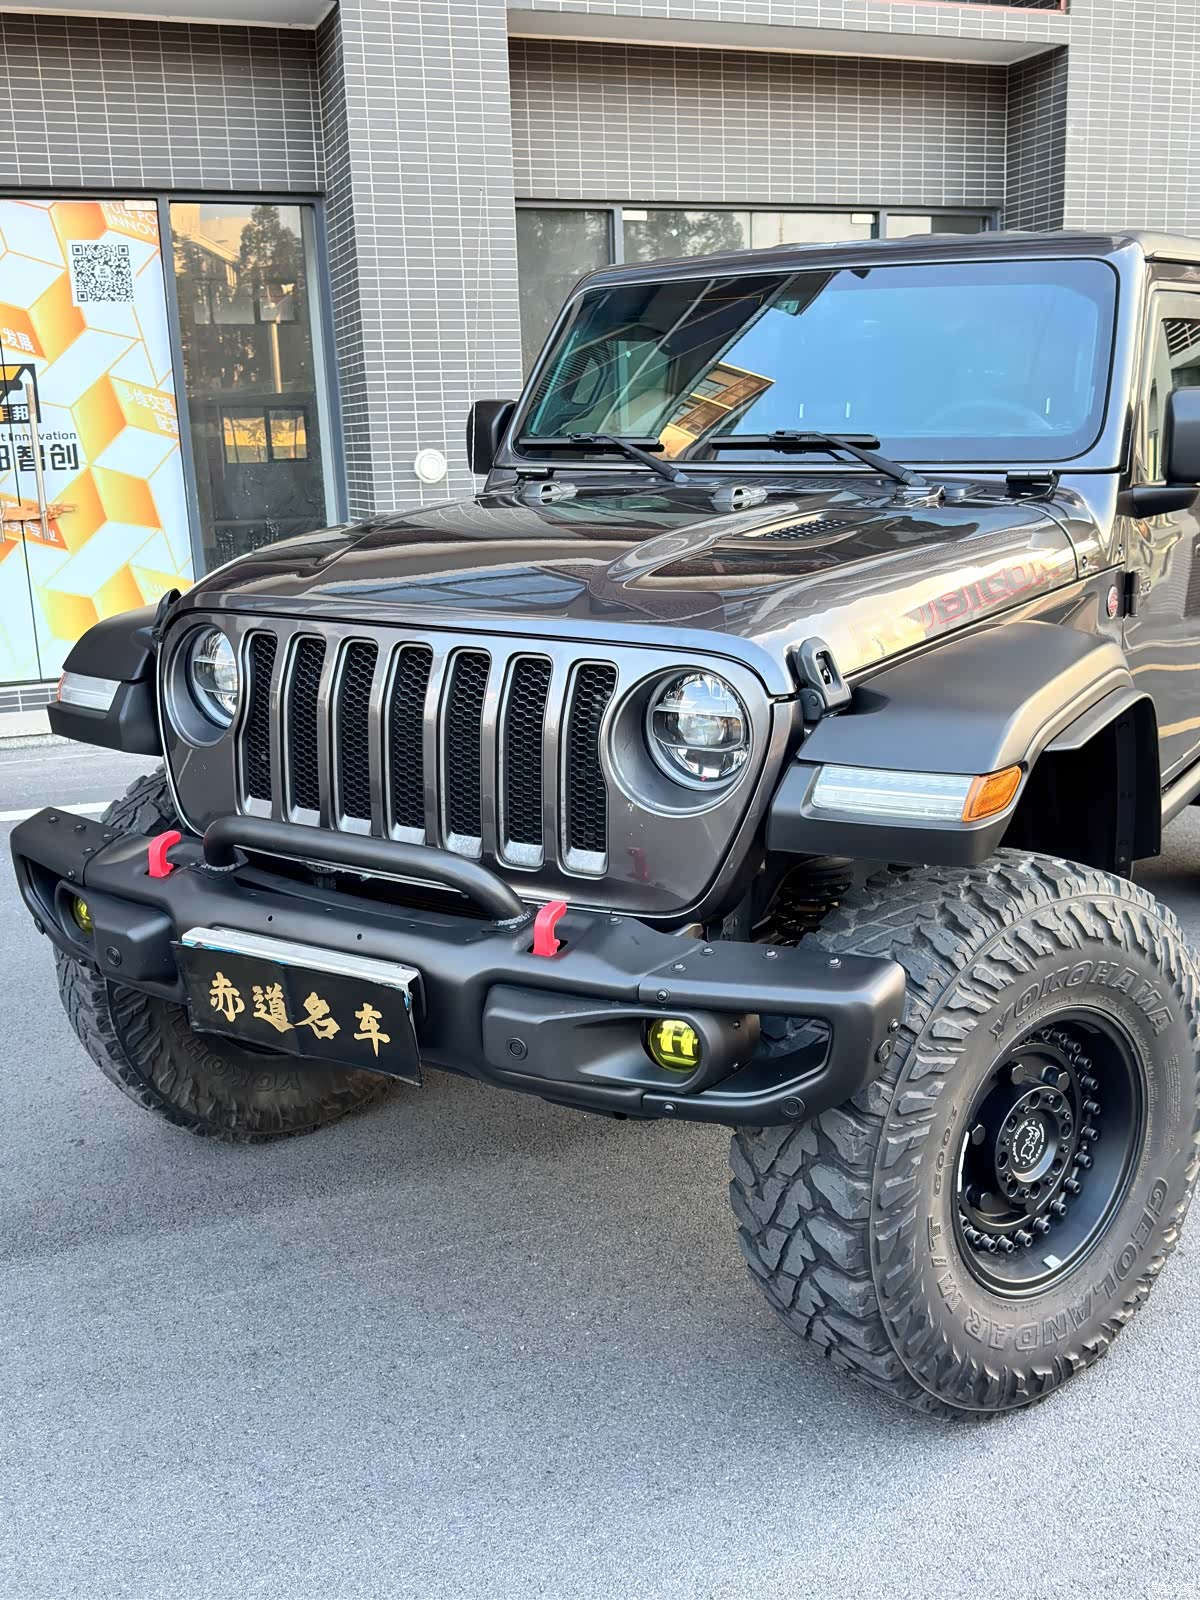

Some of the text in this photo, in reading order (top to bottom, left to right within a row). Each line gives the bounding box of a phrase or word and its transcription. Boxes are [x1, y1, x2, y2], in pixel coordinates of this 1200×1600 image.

[9, 431, 77, 442] Innvation
[209, 971, 391, 1058] 赤道名车
[989, 960, 1174, 1041] YOKOHAMA
[964, 1177, 1169, 1351] GEOLANDAR
